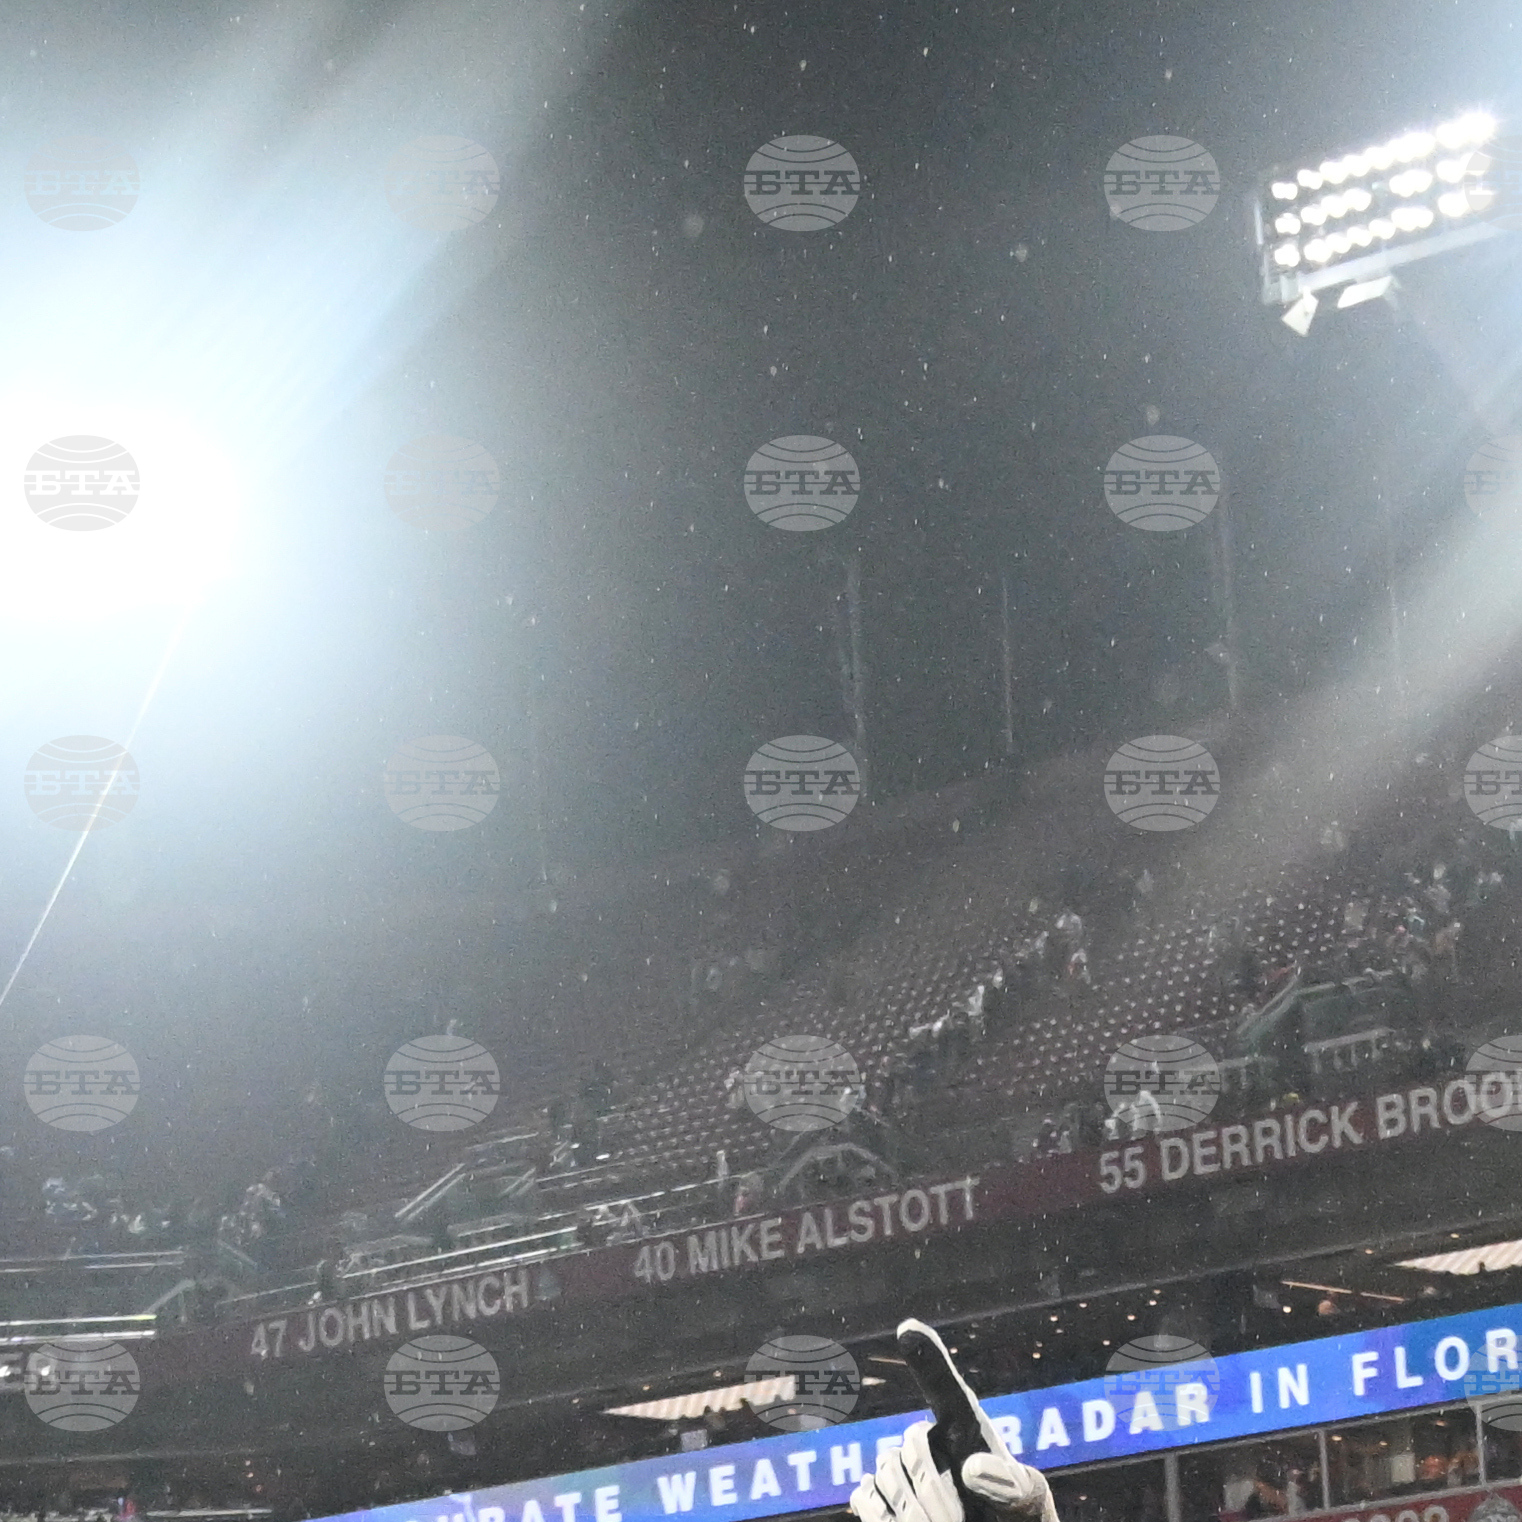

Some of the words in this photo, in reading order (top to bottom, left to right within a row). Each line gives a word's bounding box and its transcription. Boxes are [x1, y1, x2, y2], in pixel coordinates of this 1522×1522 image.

[1100, 1146, 1146, 1195] 55
[1159, 1105, 1364, 1182] DERRICK
[634, 1239, 675, 1284] 40
[688, 1216, 785, 1275] MIKE
[797, 1176, 980, 1254] ALSTOTT
[250, 1318, 287, 1360] 47
[299, 1298, 396, 1353] JOHN
[407, 1268, 530, 1331] LYNCH
[998, 1380, 1212, 1456] RADAR
[1248, 1362, 1310, 1414] IN
